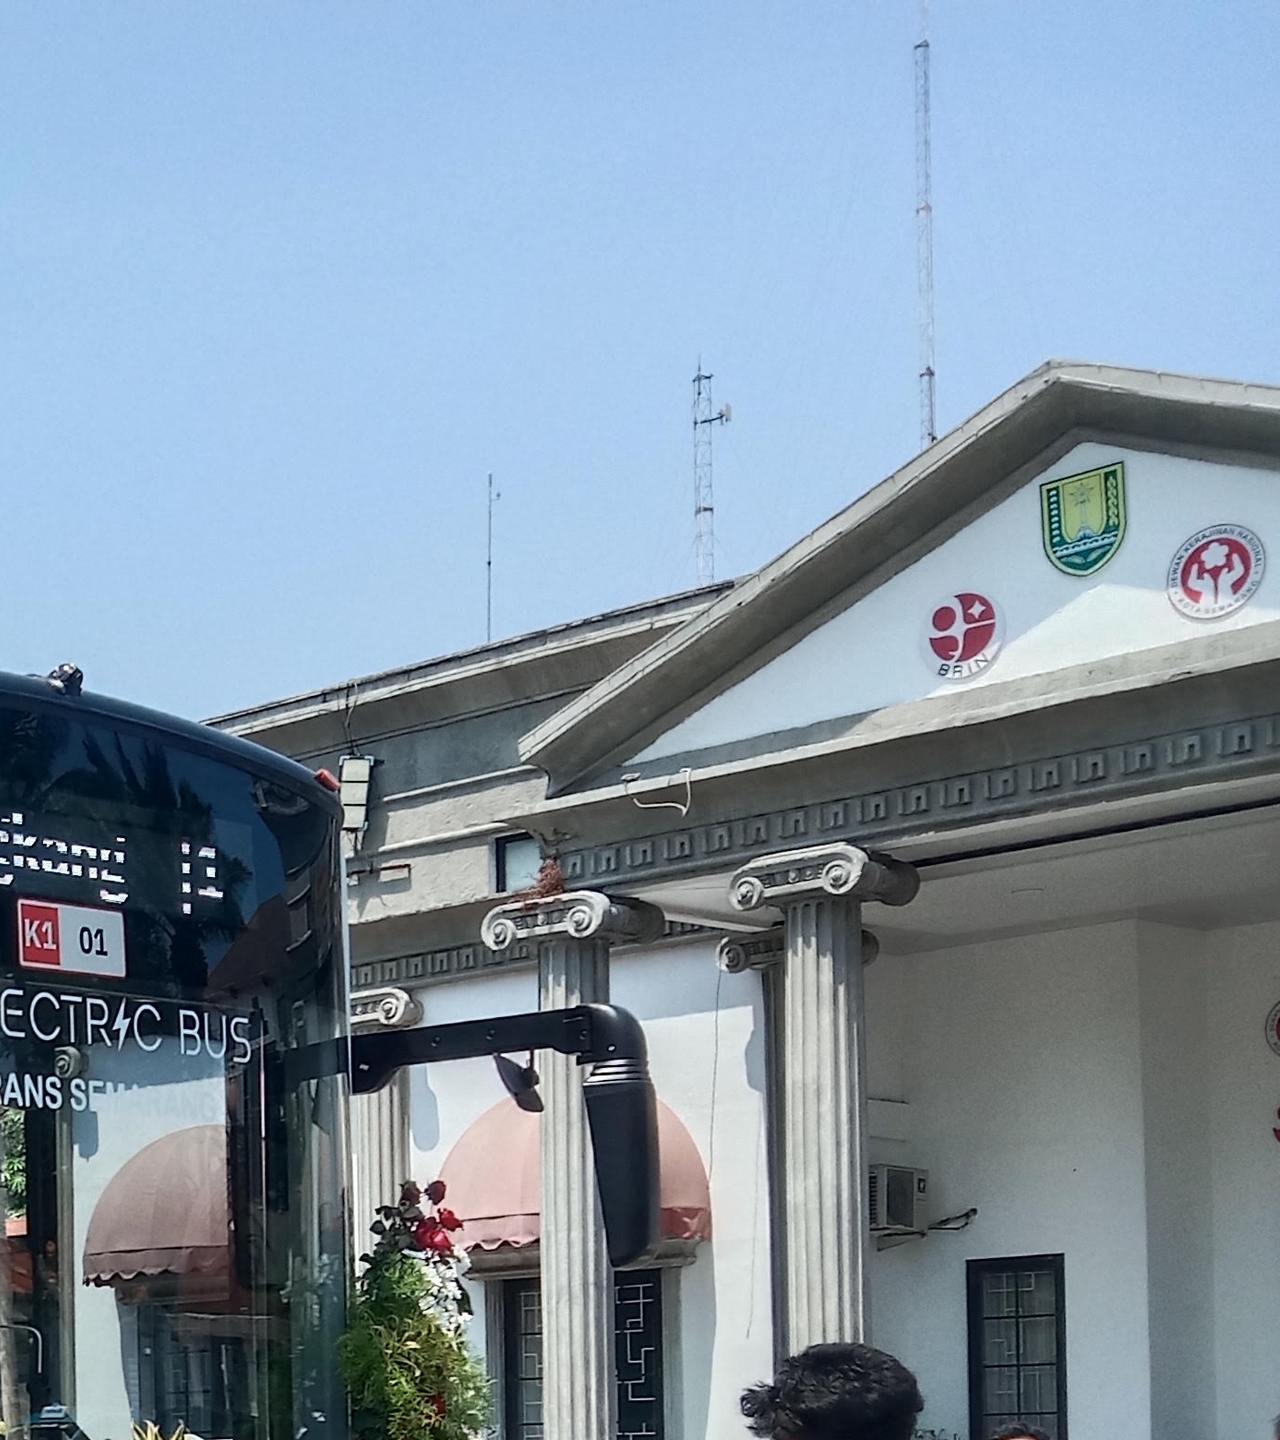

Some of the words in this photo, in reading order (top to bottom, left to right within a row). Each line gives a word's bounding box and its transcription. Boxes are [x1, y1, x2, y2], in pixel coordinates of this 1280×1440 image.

[937, 652, 990, 678] BRIN
[23, 917, 57, 951] K1
[79, 925, 108, 957] 01
[179, 1009, 252, 1065] BUS
